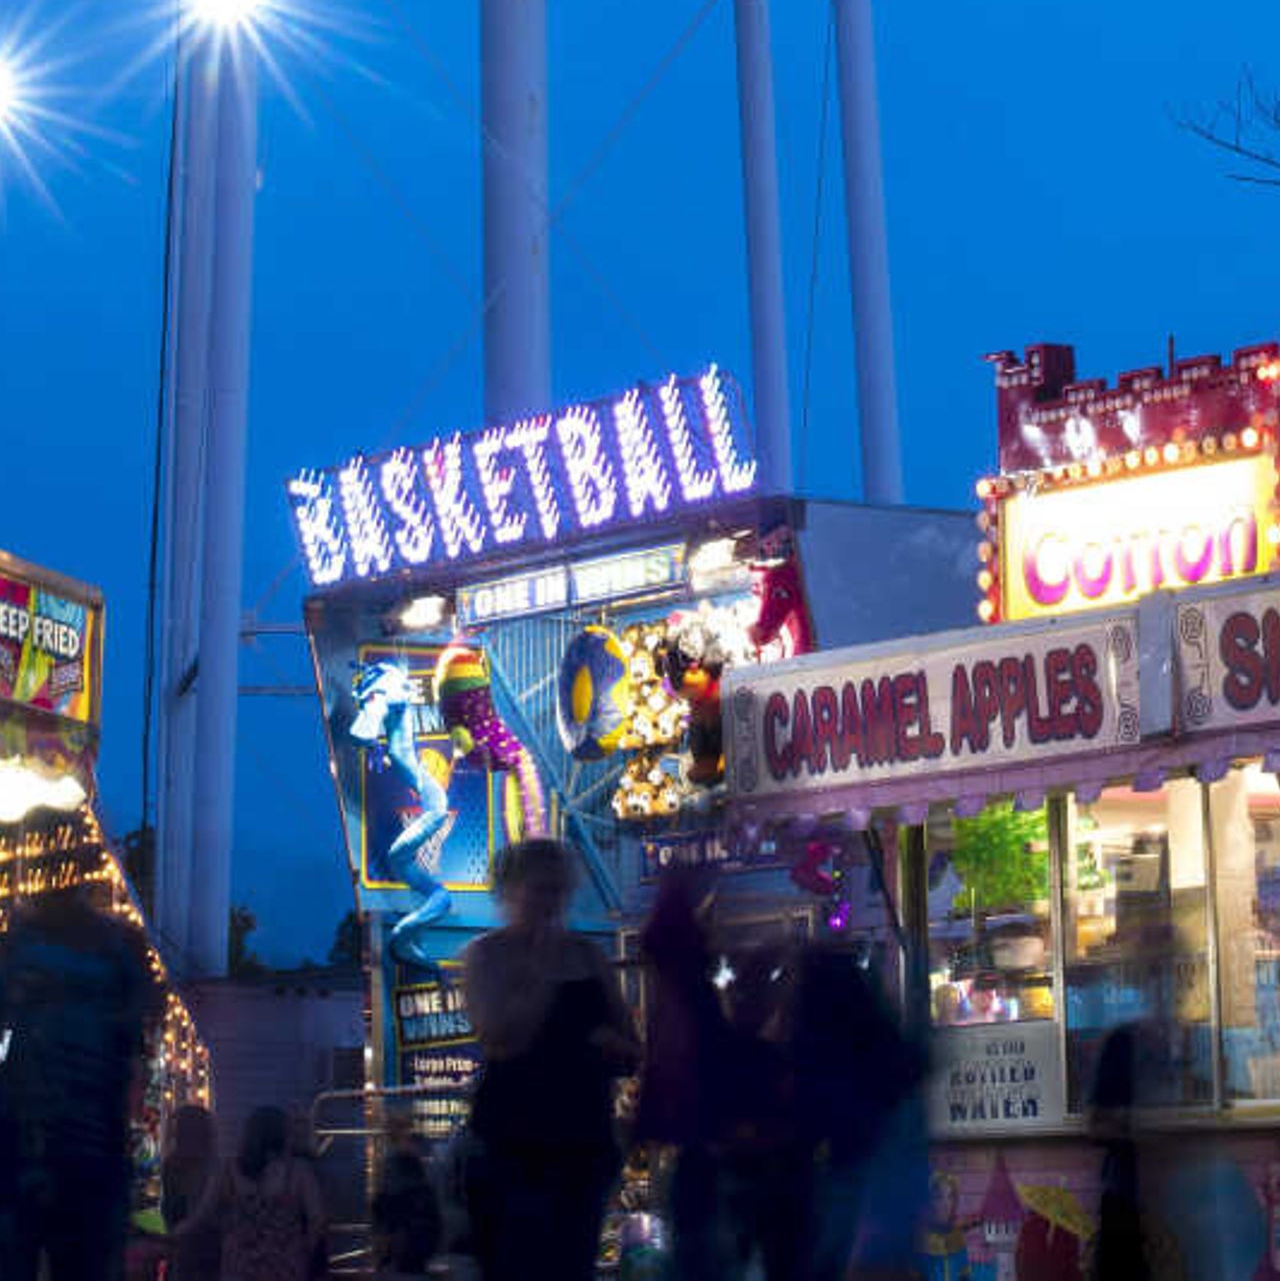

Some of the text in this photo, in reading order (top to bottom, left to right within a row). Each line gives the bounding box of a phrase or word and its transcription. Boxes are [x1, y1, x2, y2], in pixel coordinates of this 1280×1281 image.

[289, 364, 758, 585] BASKETBALL
[33, 616, 81, 658] FRIED
[763, 643, 1104, 778] CARAMEL APPLES
[399, 991, 443, 1017] ONE
